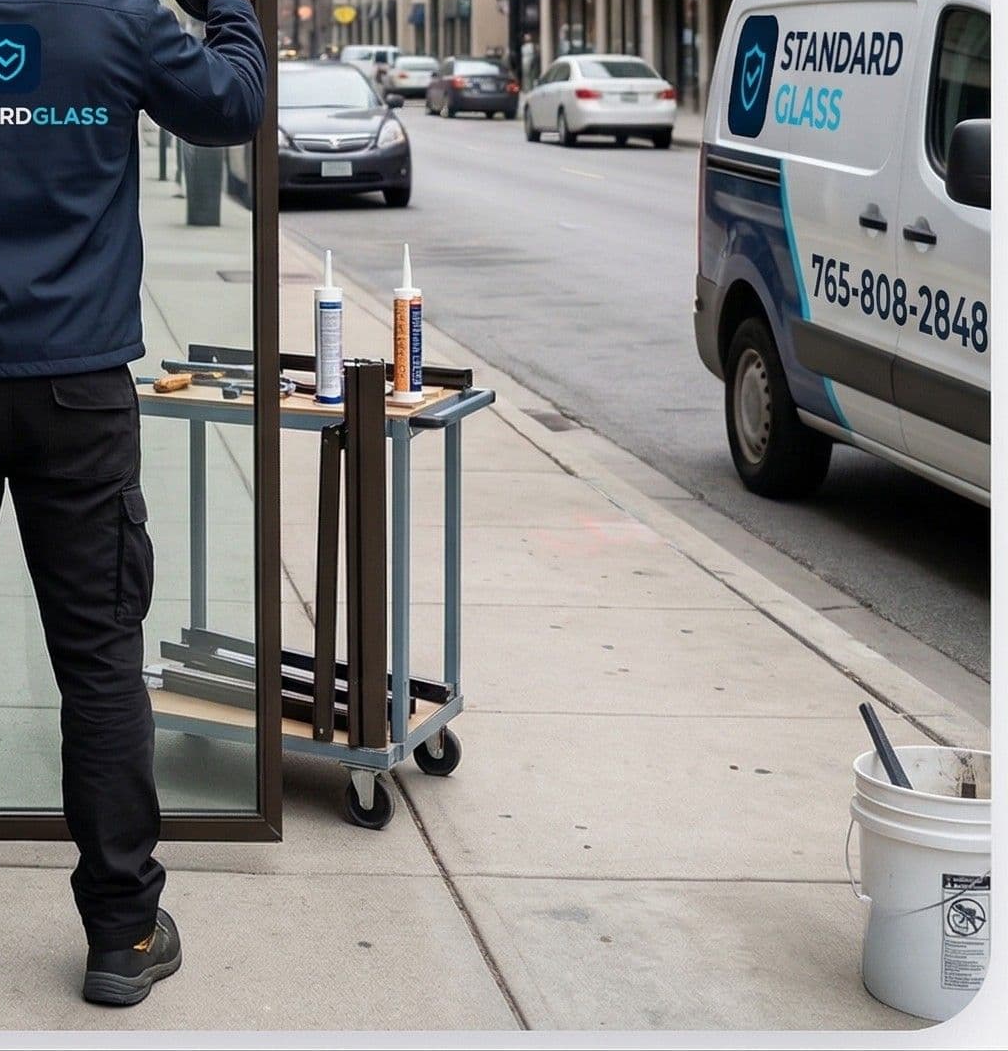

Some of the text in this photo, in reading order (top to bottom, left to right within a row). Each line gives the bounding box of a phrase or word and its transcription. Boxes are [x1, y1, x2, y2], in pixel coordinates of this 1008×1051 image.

[781, 31, 904, 76] STANDARD
[775, 85, 843, 132] GLASS
[812, 253, 988, 353] 765-808-2848
